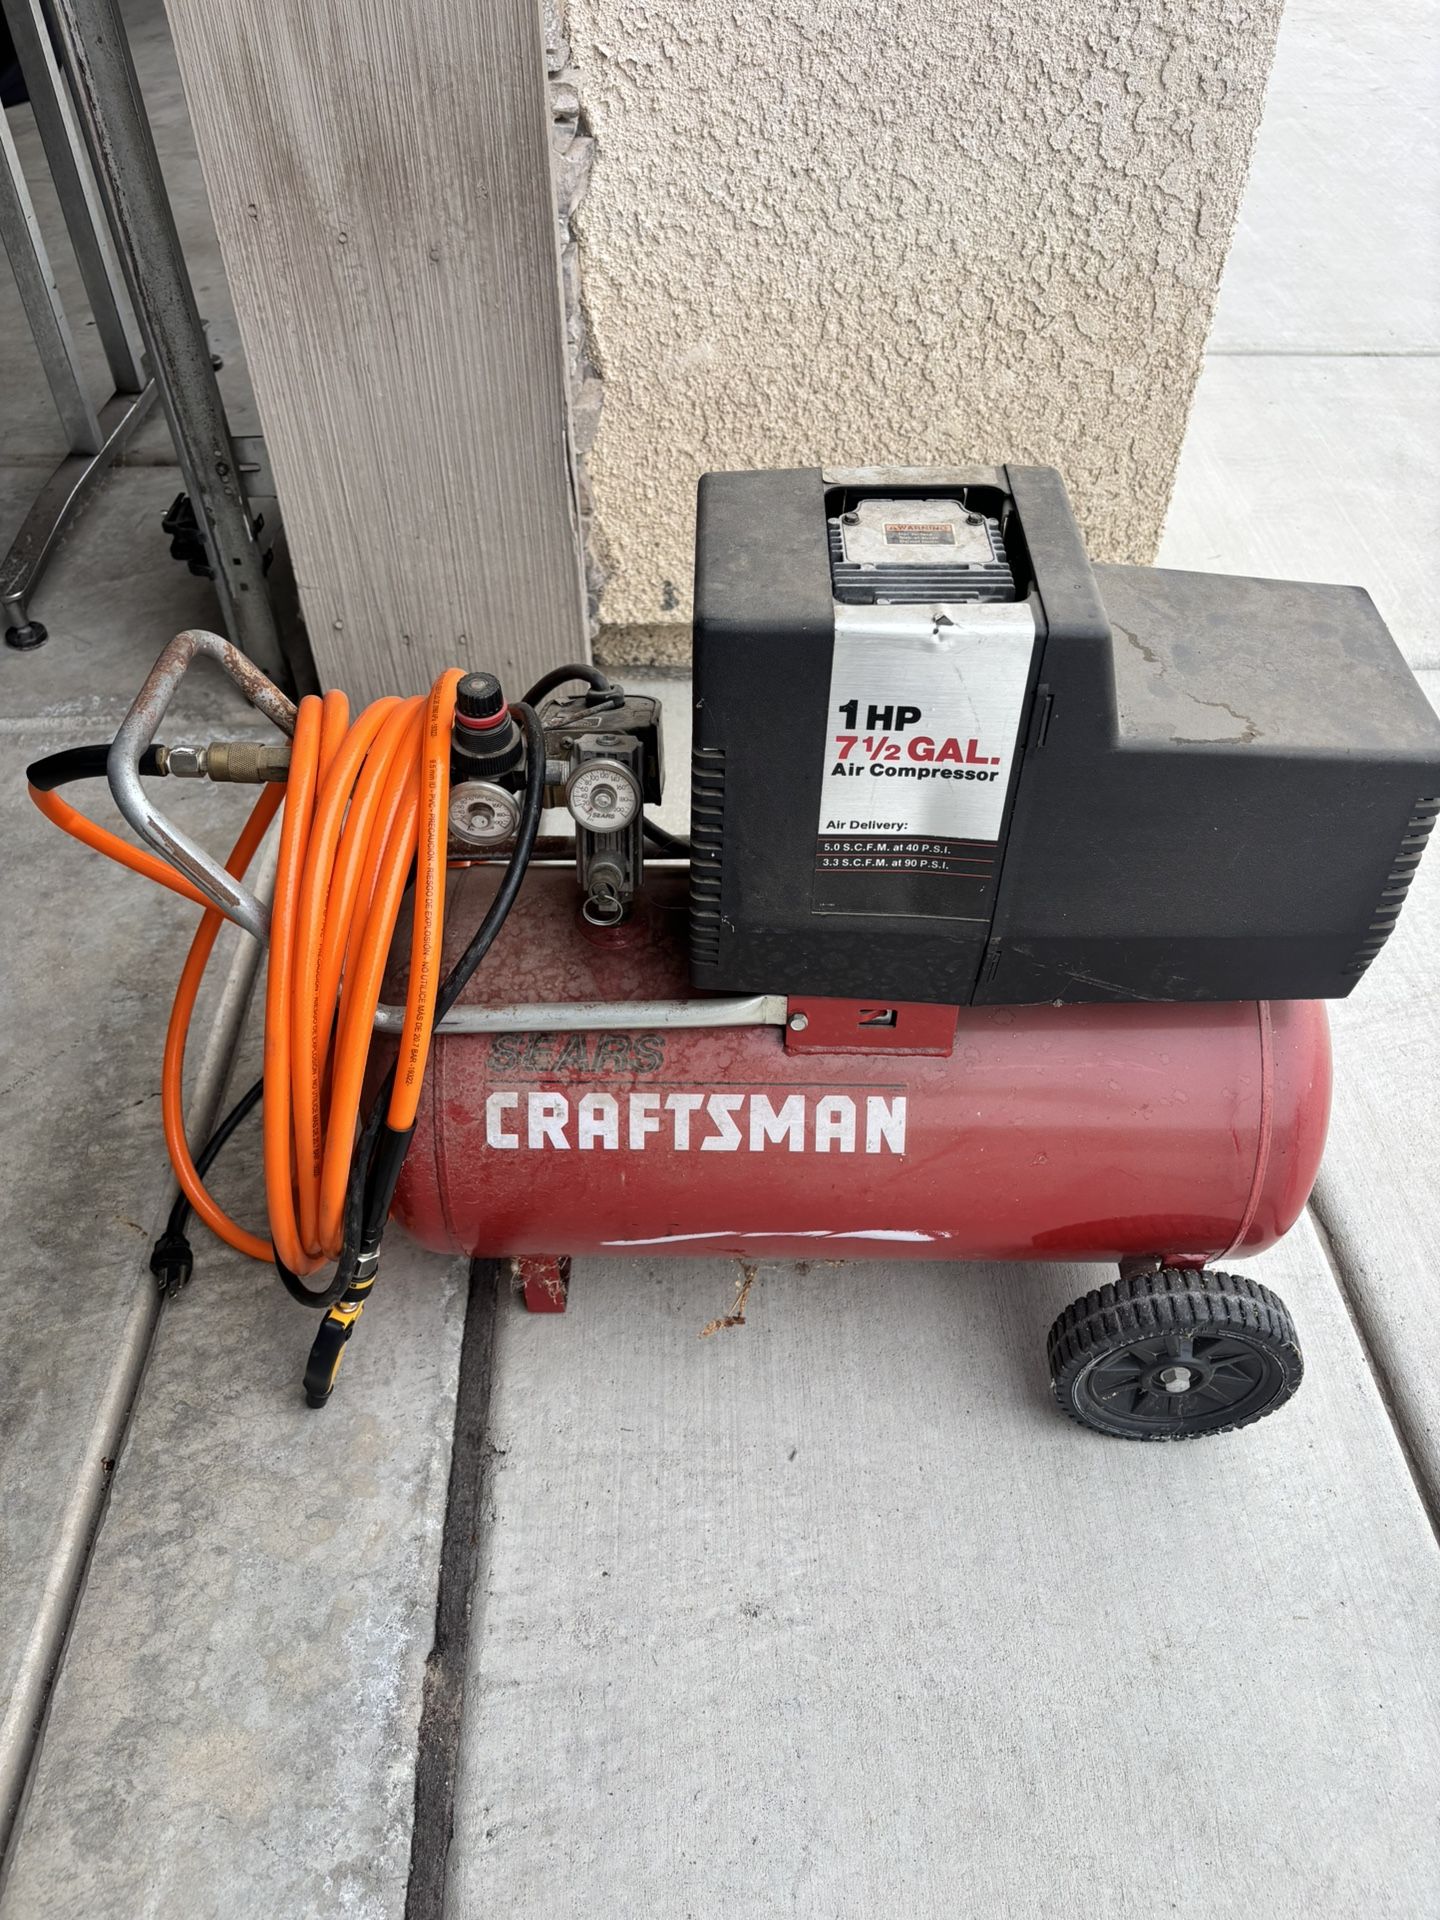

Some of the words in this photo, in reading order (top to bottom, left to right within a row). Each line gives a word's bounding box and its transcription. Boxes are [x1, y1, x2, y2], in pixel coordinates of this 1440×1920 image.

[839, 699, 858, 730] 1
[866, 705, 922, 731] HP
[907, 736, 1000, 765] GAL.
[831, 763, 865, 776] Air
[869, 763, 999, 782] Compressor
[826, 820, 846, 830] Air
[849, 820, 908, 831] Delivery:
[824, 843, 840, 851] 5.0
[843, 843, 890, 852] S.C.F.M.
[893, 843, 903, 852] at
[906, 843, 919, 852] 40
[921, 844, 951, 855] P.S.I.
[822, 858, 839, 867] 3.3
[842, 858, 889, 867] S.C.F.M.
[891, 859, 902, 867] at
[904, 859, 918, 867] 90
[920, 860, 949, 870] P.S.I.
[426, 867, 434, 896] RIESGO
[425, 899, 433, 909] DE
[421, 962, 429, 973] NO
[419, 975, 428, 1004] UTILICE
[414, 1022, 423, 1032] DE
[409, 1049, 419, 1063] BAR
[485, 1032, 666, 1073] SEARS
[485, 1091, 907, 1154] CRAFTSMAN
